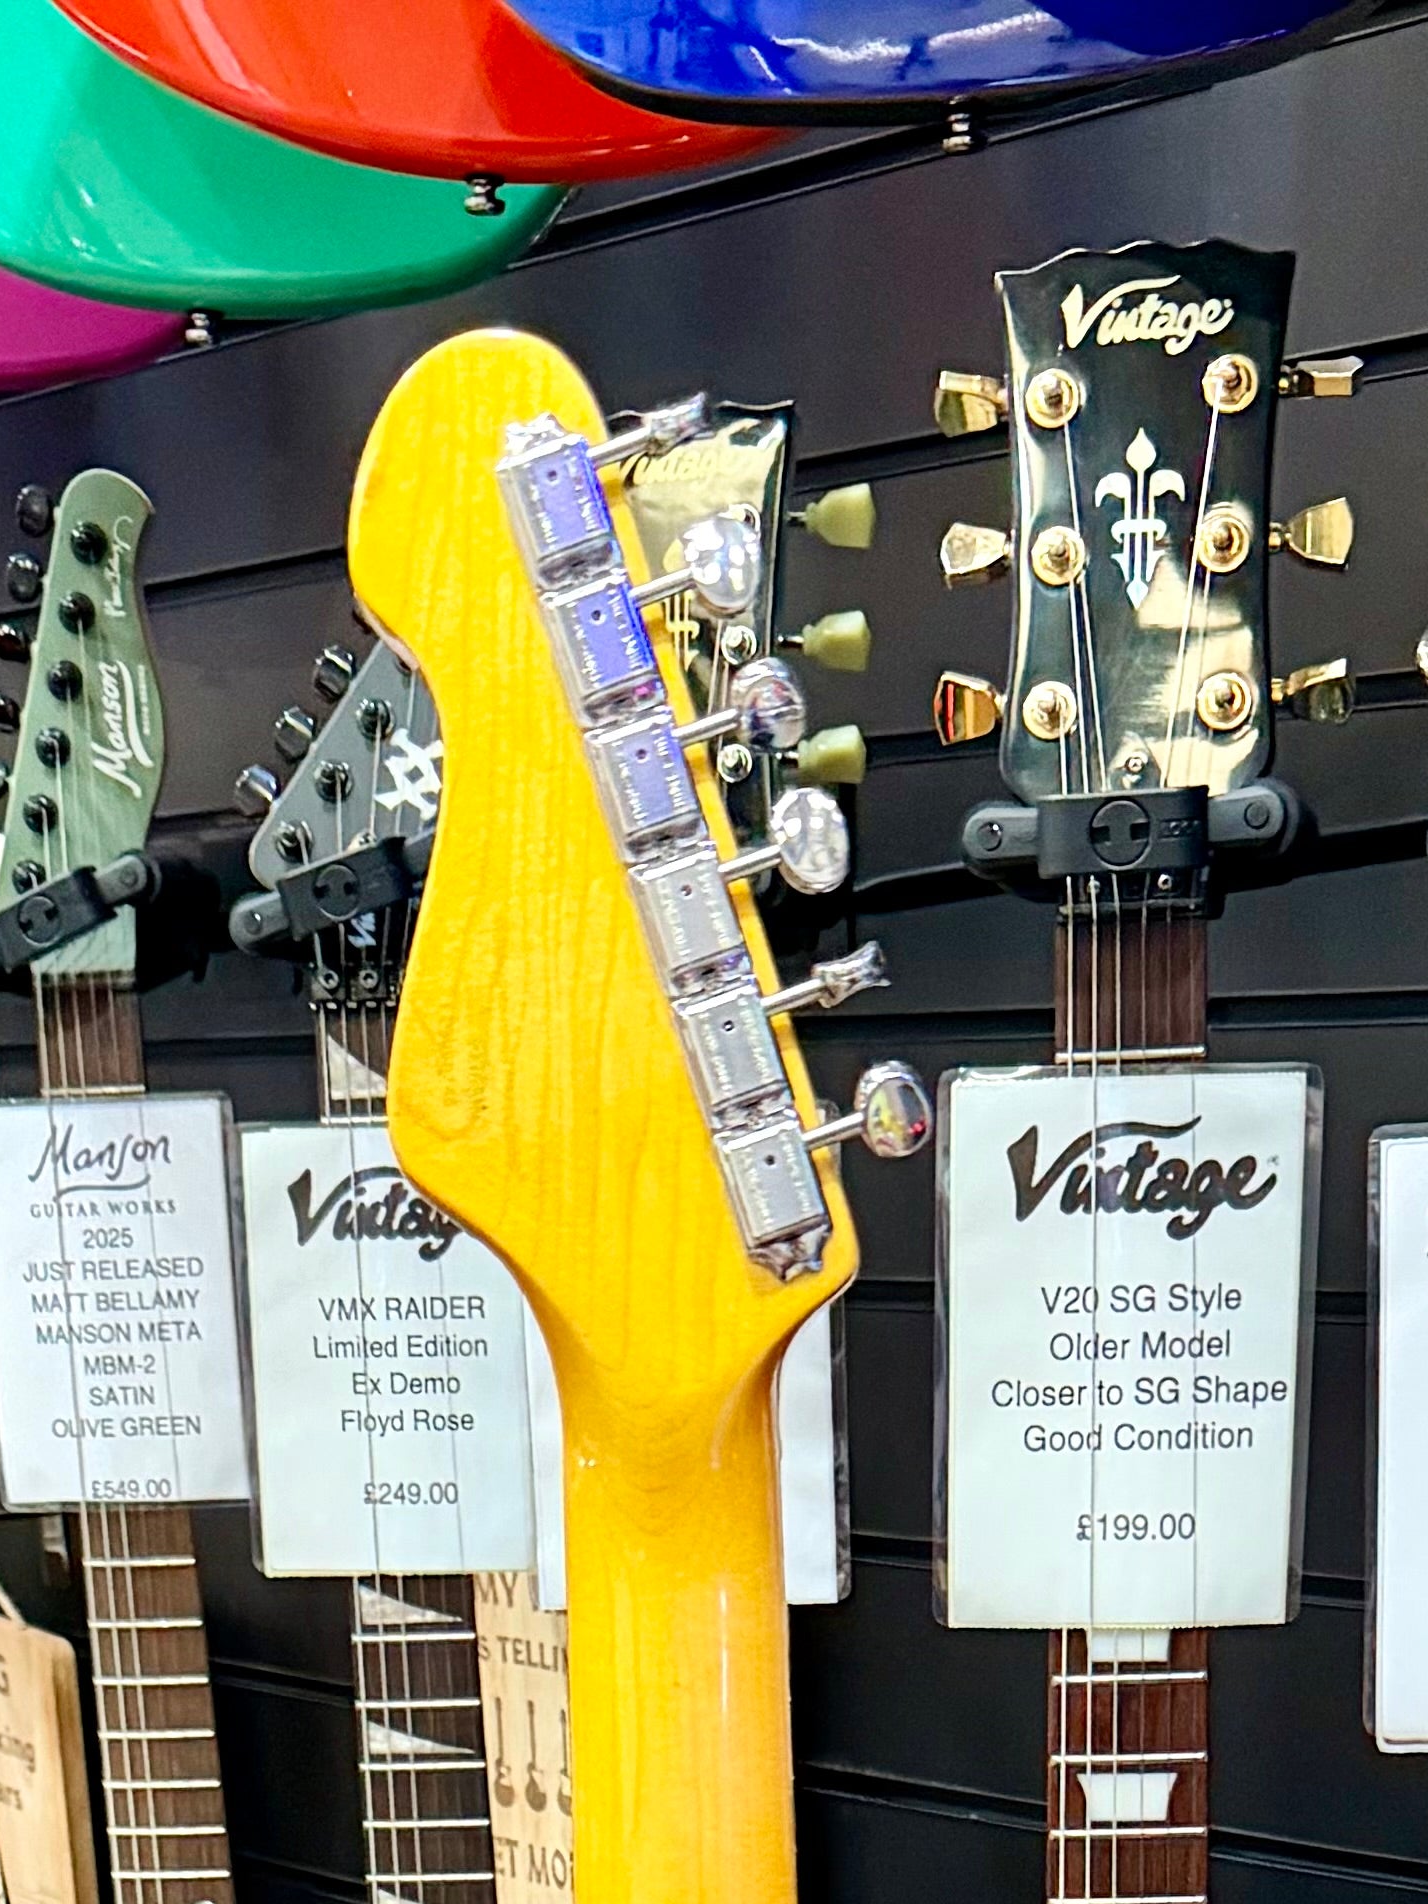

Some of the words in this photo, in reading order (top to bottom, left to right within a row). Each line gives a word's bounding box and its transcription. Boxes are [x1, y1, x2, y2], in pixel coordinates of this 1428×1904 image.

[1060, 275, 1234, 356] Vintage
[92, 661, 144, 799] Manson
[28, 1123, 170, 1184] Manson
[1006, 1116, 1277, 1241] Vintage
[30, 1201, 100, 1219] GUITAR
[107, 1200, 178, 1216] WORKS
[83, 1228, 134, 1249] 2025
[23, 1261, 76, 1283] JUST
[82, 1258, 204, 1282] RELEASED
[31, 1292, 89, 1314] MATT
[96, 1290, 201, 1313] BELLAMY
[318, 1297, 378, 1322] VMX
[384, 1296, 486, 1321] RAIDER
[1041, 1286, 1099, 1315] V20
[1109, 1285, 1156, 1312] SG
[1169, 1282, 1243, 1318] Style
[36, 1323, 131, 1345] MANSON
[136, 1321, 204, 1343] META
[1049, 1332, 1131, 1361] Older
[1141, 1329, 1232, 1359] Model
[312, 1334, 399, 1360] Limited
[405, 1334, 489, 1360] Edition
[84, 1355, 157, 1377] MBM-2
[88, 1386, 156, 1408] SATIN
[352, 1372, 383, 1396] Ex
[390, 1372, 462, 1396] Demo
[992, 1379, 1089, 1408] Closer
[1097, 1379, 1125, 1405] to
[1134, 1378, 1180, 1405] SG
[1192, 1375, 1289, 1411] Shape
[51, 1418, 115, 1440] OLIVE
[121, 1416, 203, 1439] GREEN
[340, 1408, 408, 1438] Floyd
[413, 1409, 475, 1433] Rose
[1023, 1424, 1103, 1452] Good
[1113, 1421, 1254, 1451] Condition
[91, 1479, 172, 1500] £549.00
[362, 1480, 459, 1507] £249.00
[1076, 1513, 1197, 1541] £199.00
